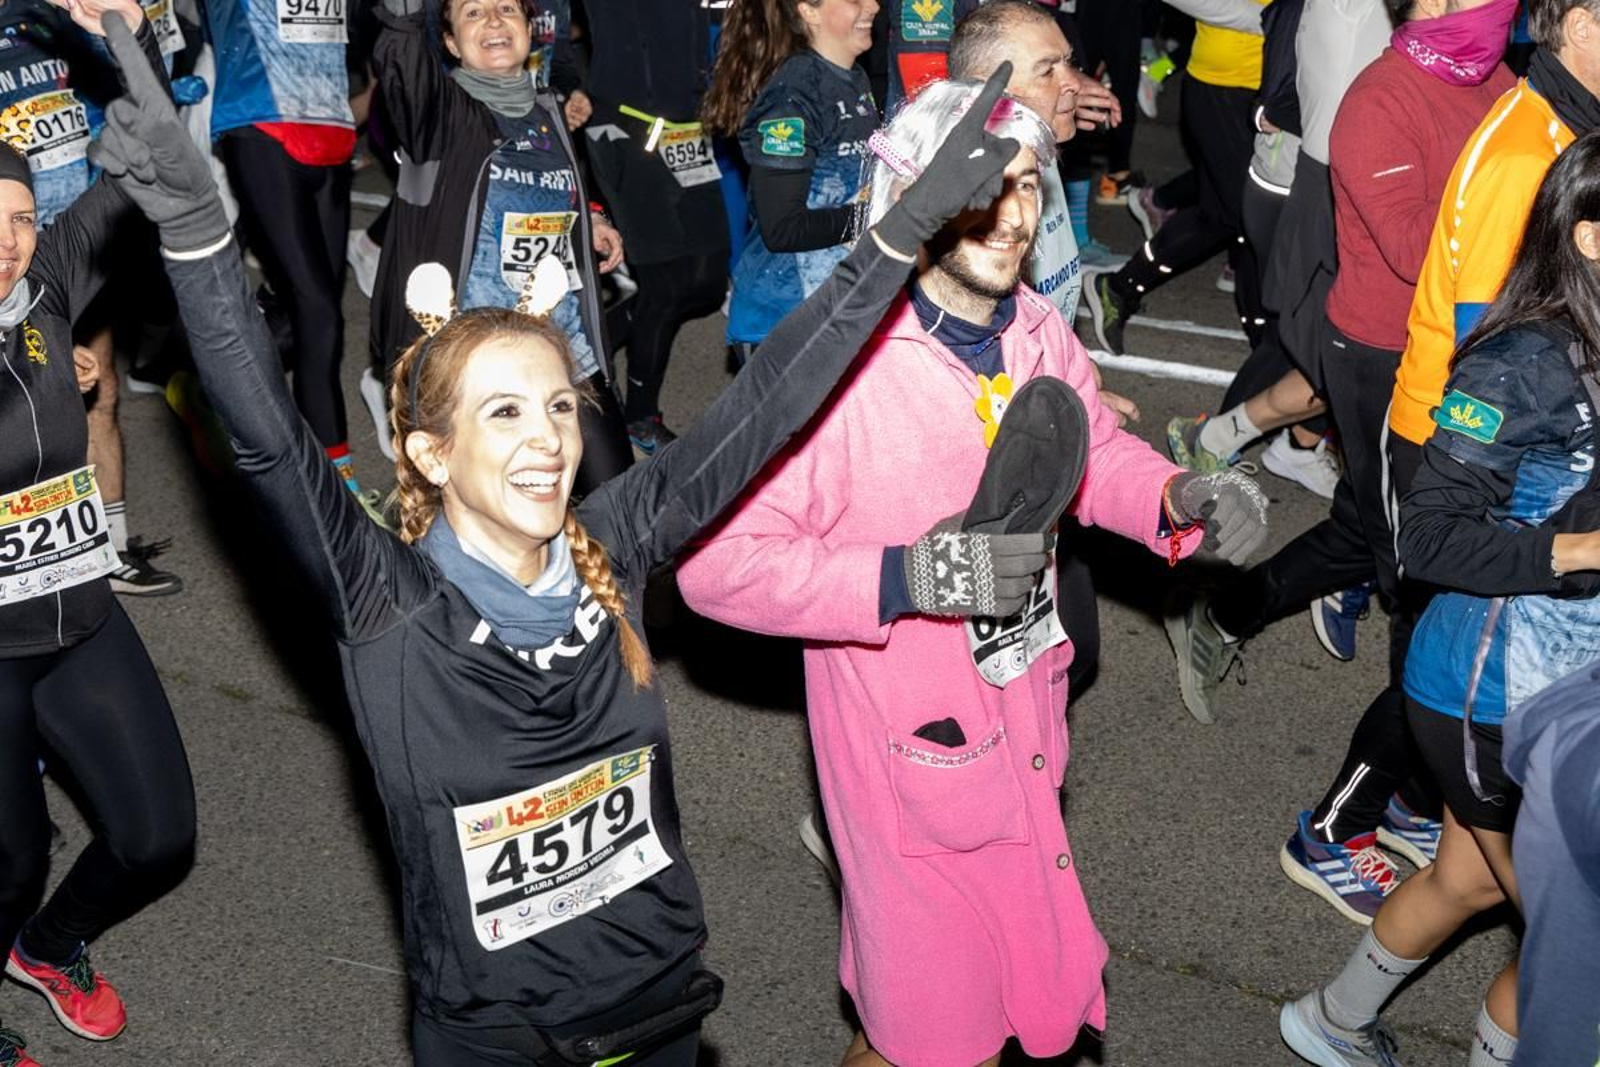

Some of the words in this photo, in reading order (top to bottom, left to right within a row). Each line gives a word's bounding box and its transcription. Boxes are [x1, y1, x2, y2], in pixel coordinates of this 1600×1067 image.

[282, 0, 342, 16] 9470
[665, 139, 708, 166] 6594
[10, 494, 35, 516] 42
[0, 500, 98, 563] 5210
[506, 796, 545, 827] 42
[486, 786, 634, 887] 4579
[523, 880, 555, 895] LAURA
